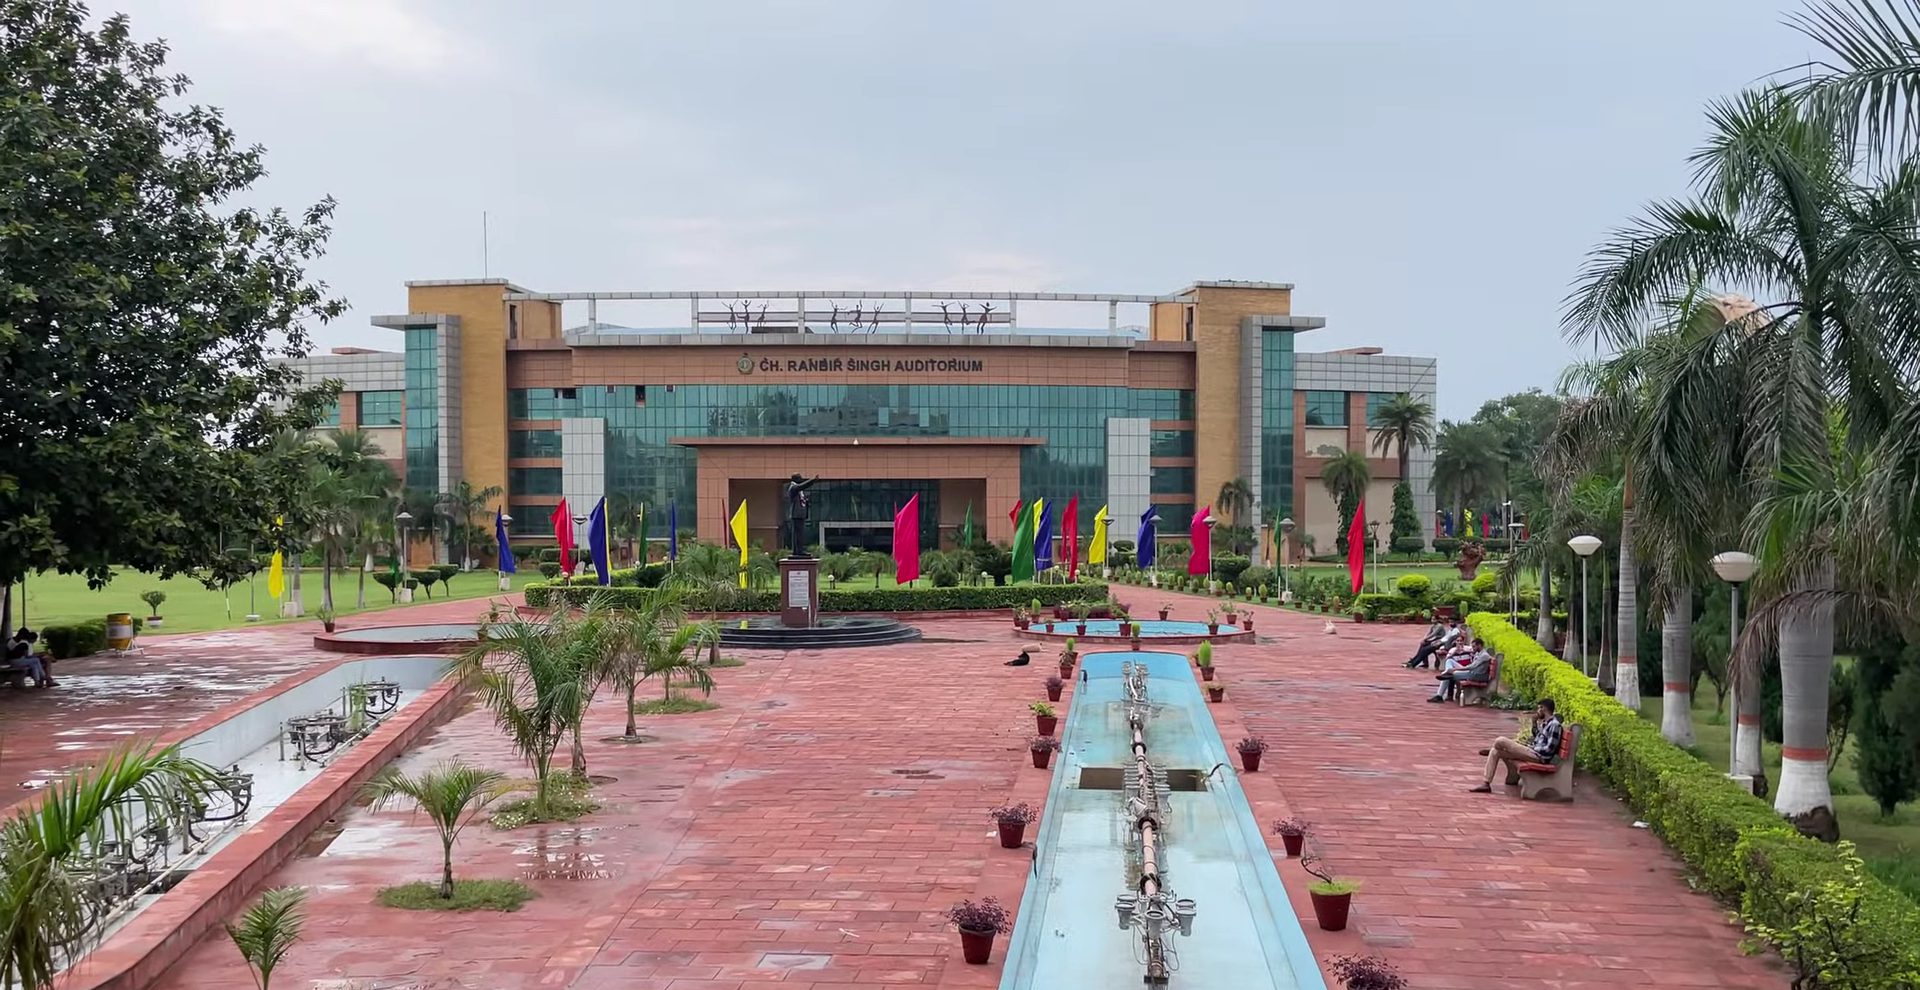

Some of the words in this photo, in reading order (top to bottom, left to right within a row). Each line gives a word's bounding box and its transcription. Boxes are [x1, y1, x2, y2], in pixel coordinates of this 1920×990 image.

[759, 359, 783, 372] CH.
[788, 359, 843, 372] RANBIR
[847, 359, 890, 372] SINGH
[894, 359, 983, 372] AUDITORIUM
